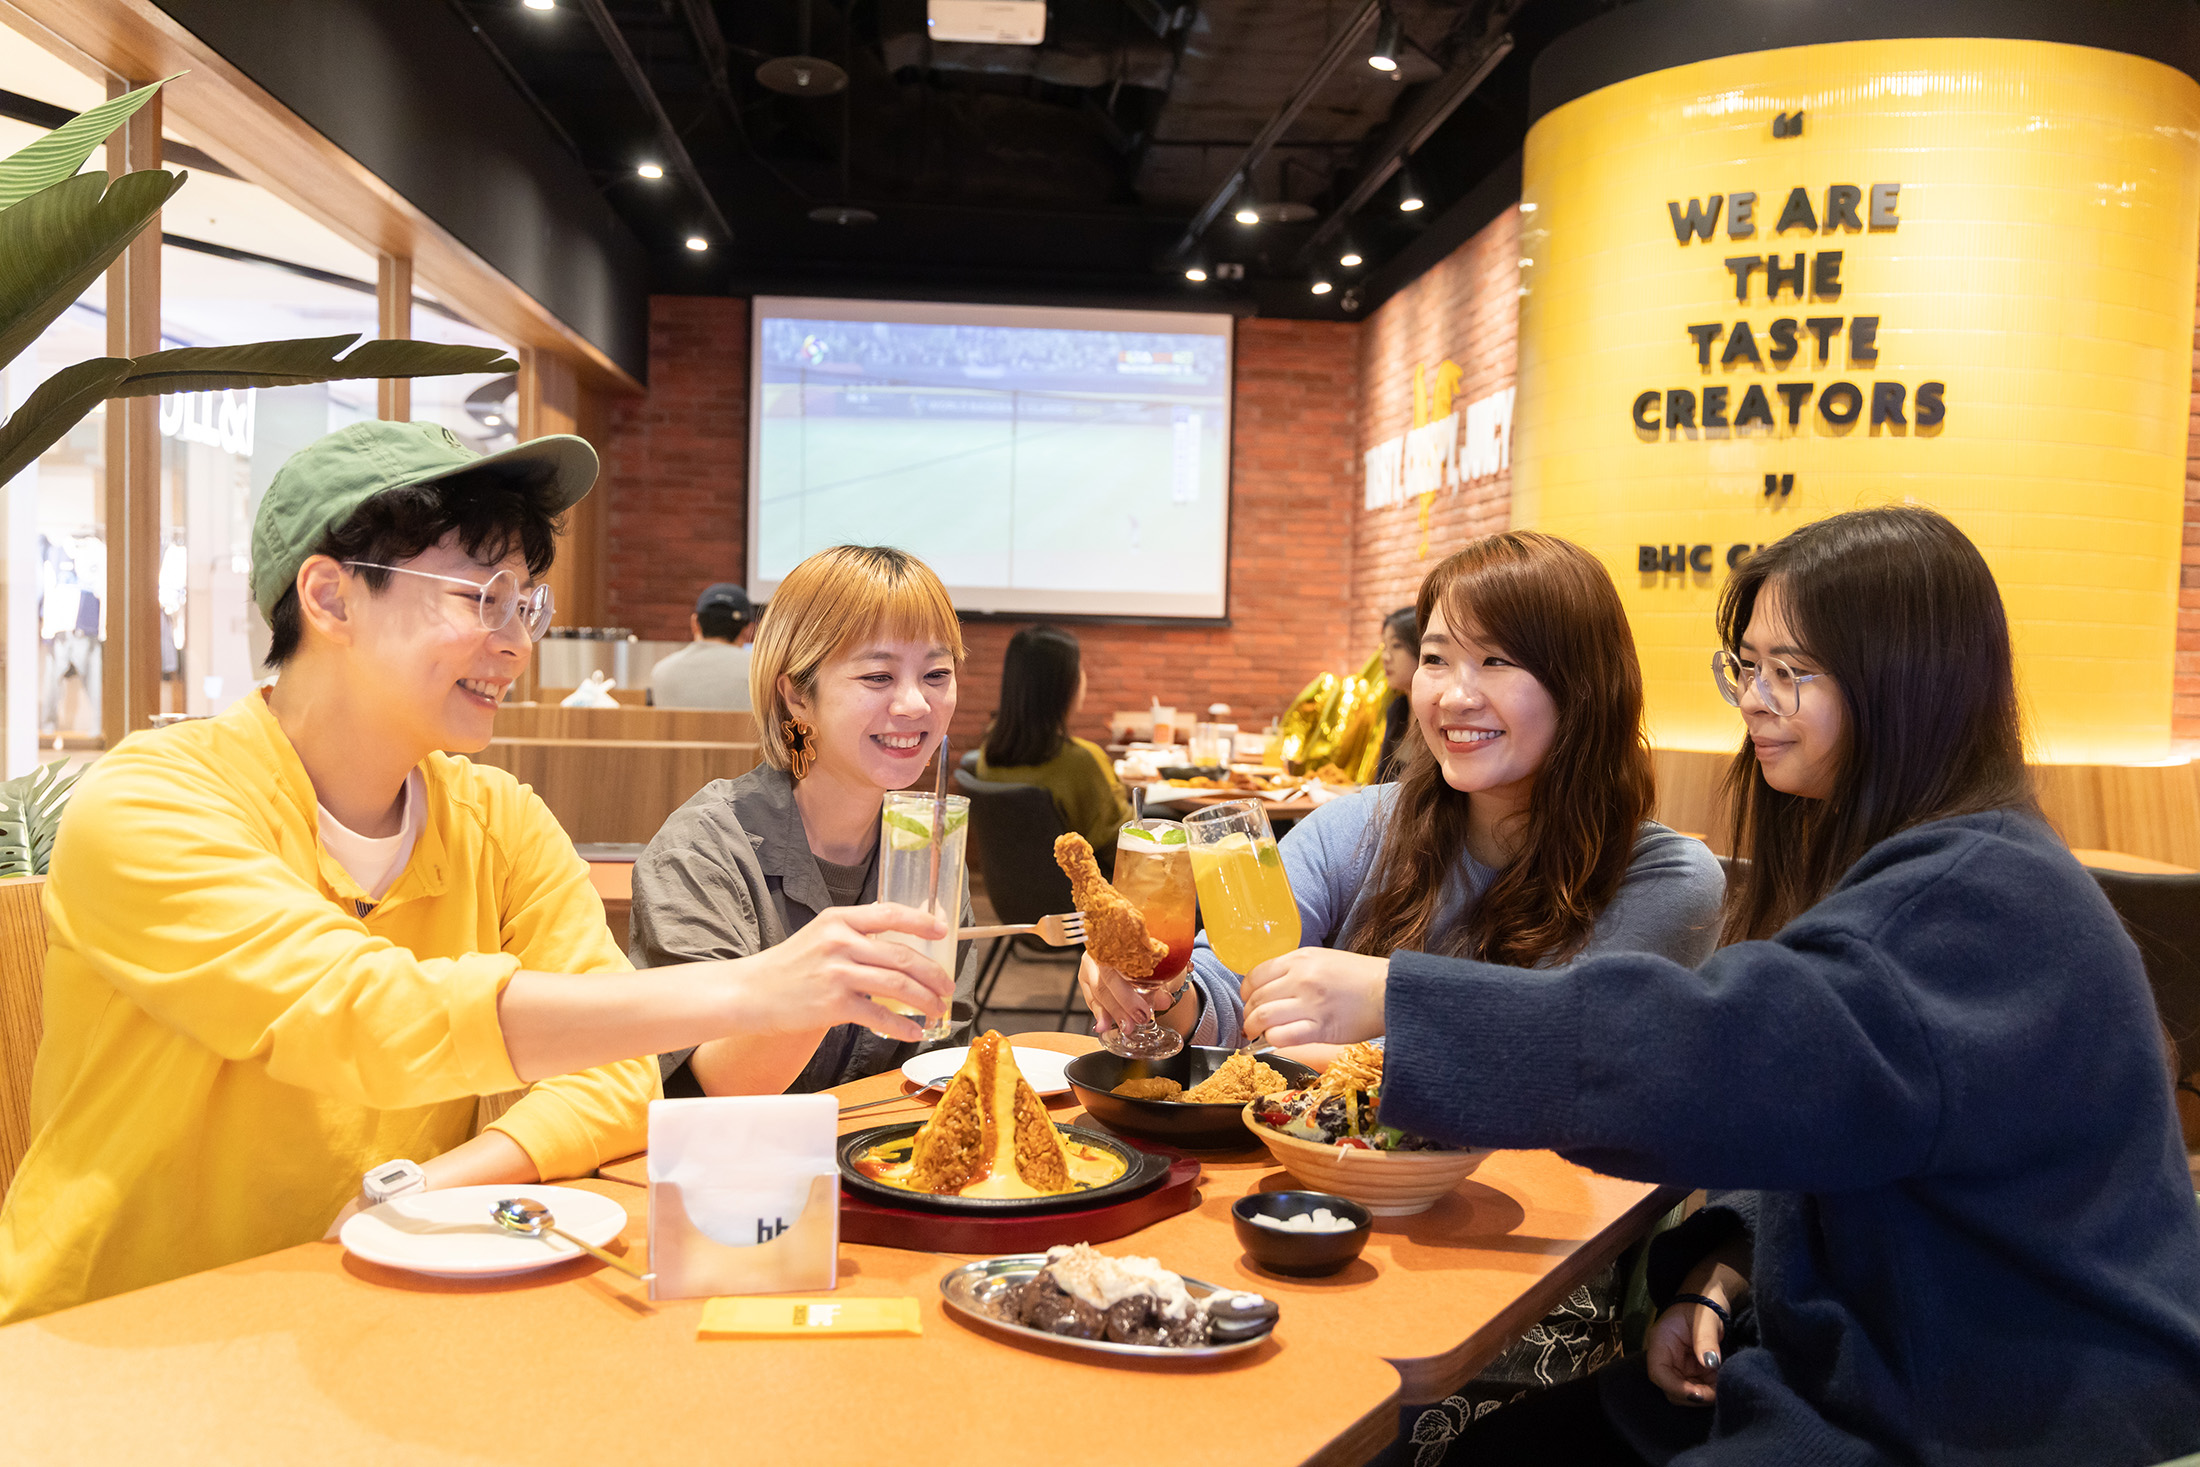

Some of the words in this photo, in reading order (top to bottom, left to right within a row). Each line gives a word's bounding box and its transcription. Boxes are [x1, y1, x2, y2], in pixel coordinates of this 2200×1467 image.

[1667, 191, 1757, 245] WE
[1776, 183, 1900, 234] ARE
[1724, 251, 1843, 302] THE
[1687, 316, 1879, 371] TASTE
[1632, 381, 1946, 432] CREATORS
[1638, 545, 1712, 573] BHC
